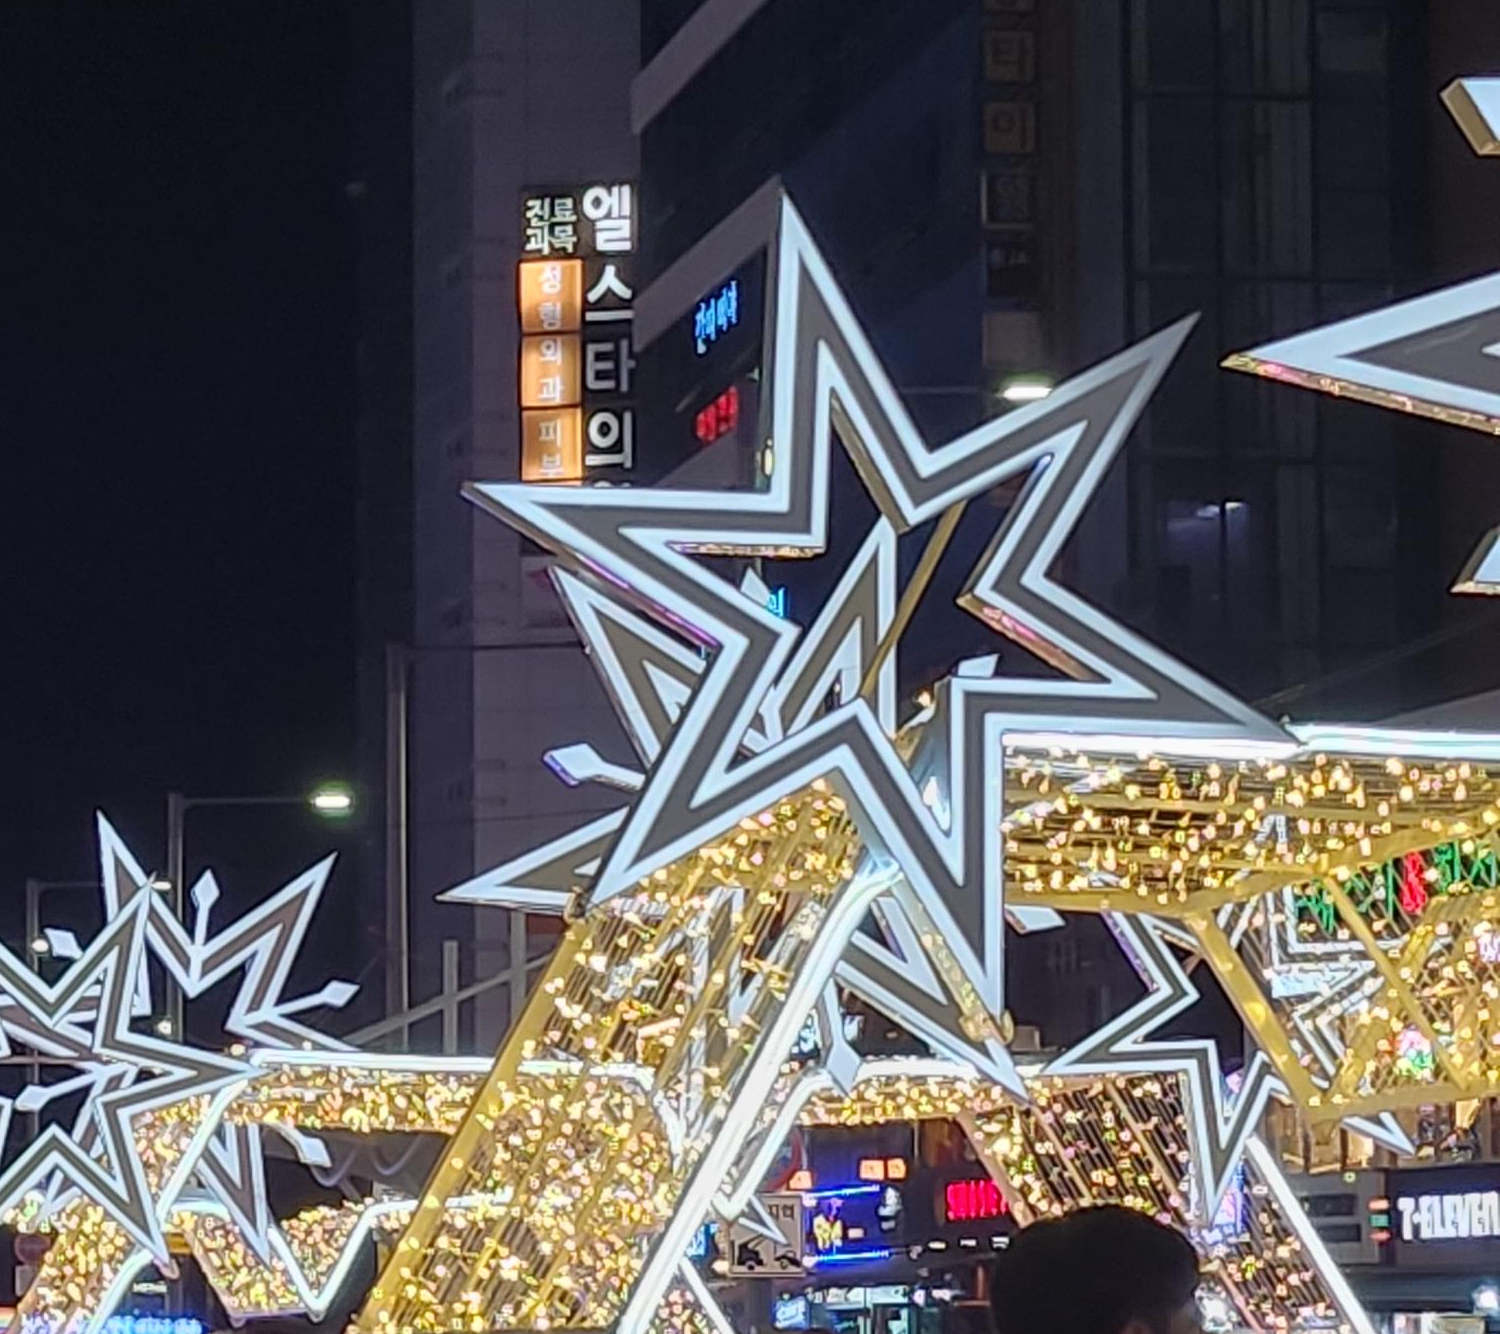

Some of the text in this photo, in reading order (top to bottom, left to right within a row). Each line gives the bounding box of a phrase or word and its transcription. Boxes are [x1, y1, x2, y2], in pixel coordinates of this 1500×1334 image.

[525, 197, 577, 227] 진료
[524, 224, 577, 255] 과목
[582, 184, 636, 487] 엘스타의
